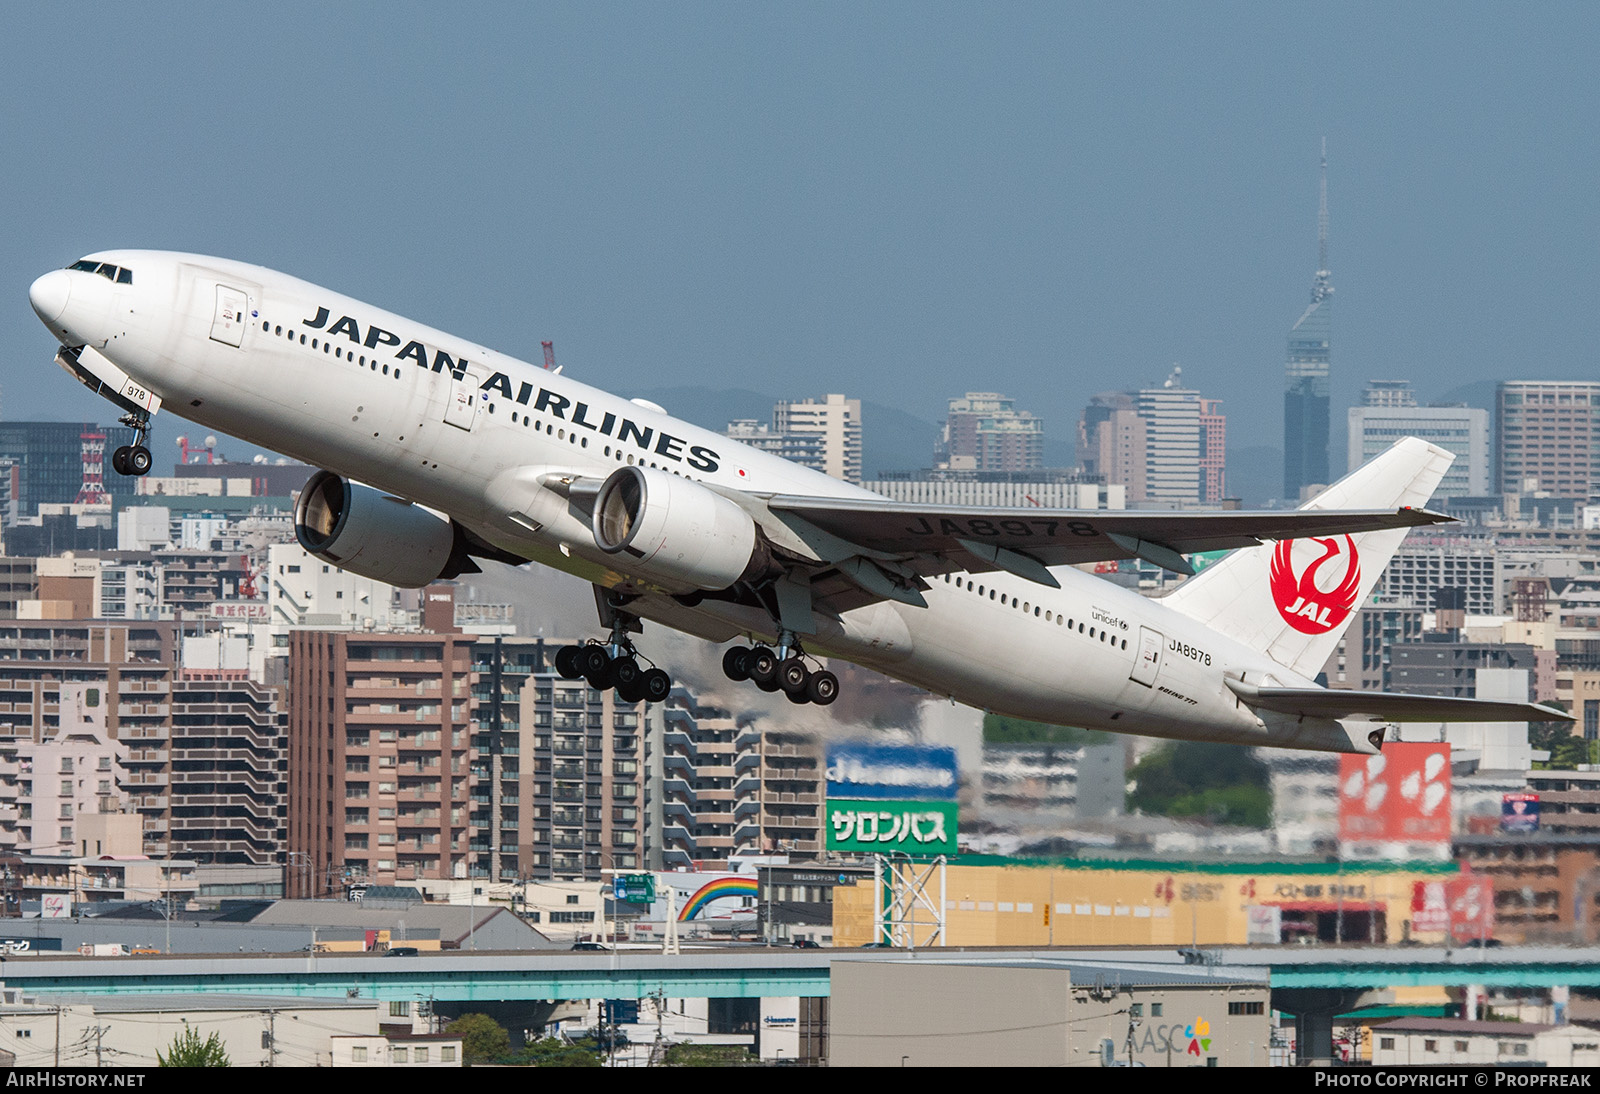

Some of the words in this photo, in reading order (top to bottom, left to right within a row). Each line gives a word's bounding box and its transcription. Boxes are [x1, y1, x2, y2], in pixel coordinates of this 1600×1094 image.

[127, 386, 145, 400] 978
[302, 306, 469, 381] JAPAN
[479, 371, 721, 473] AIRLINES
[904, 517, 1100, 538] JA8978
[1092, 611, 1119, 628] unicef
[1285, 596, 1332, 628] JAL
[1169, 639, 1212, 667] JA8978
[1158, 686, 1185, 700] BOEING
[1184, 697, 1198, 706] 777
